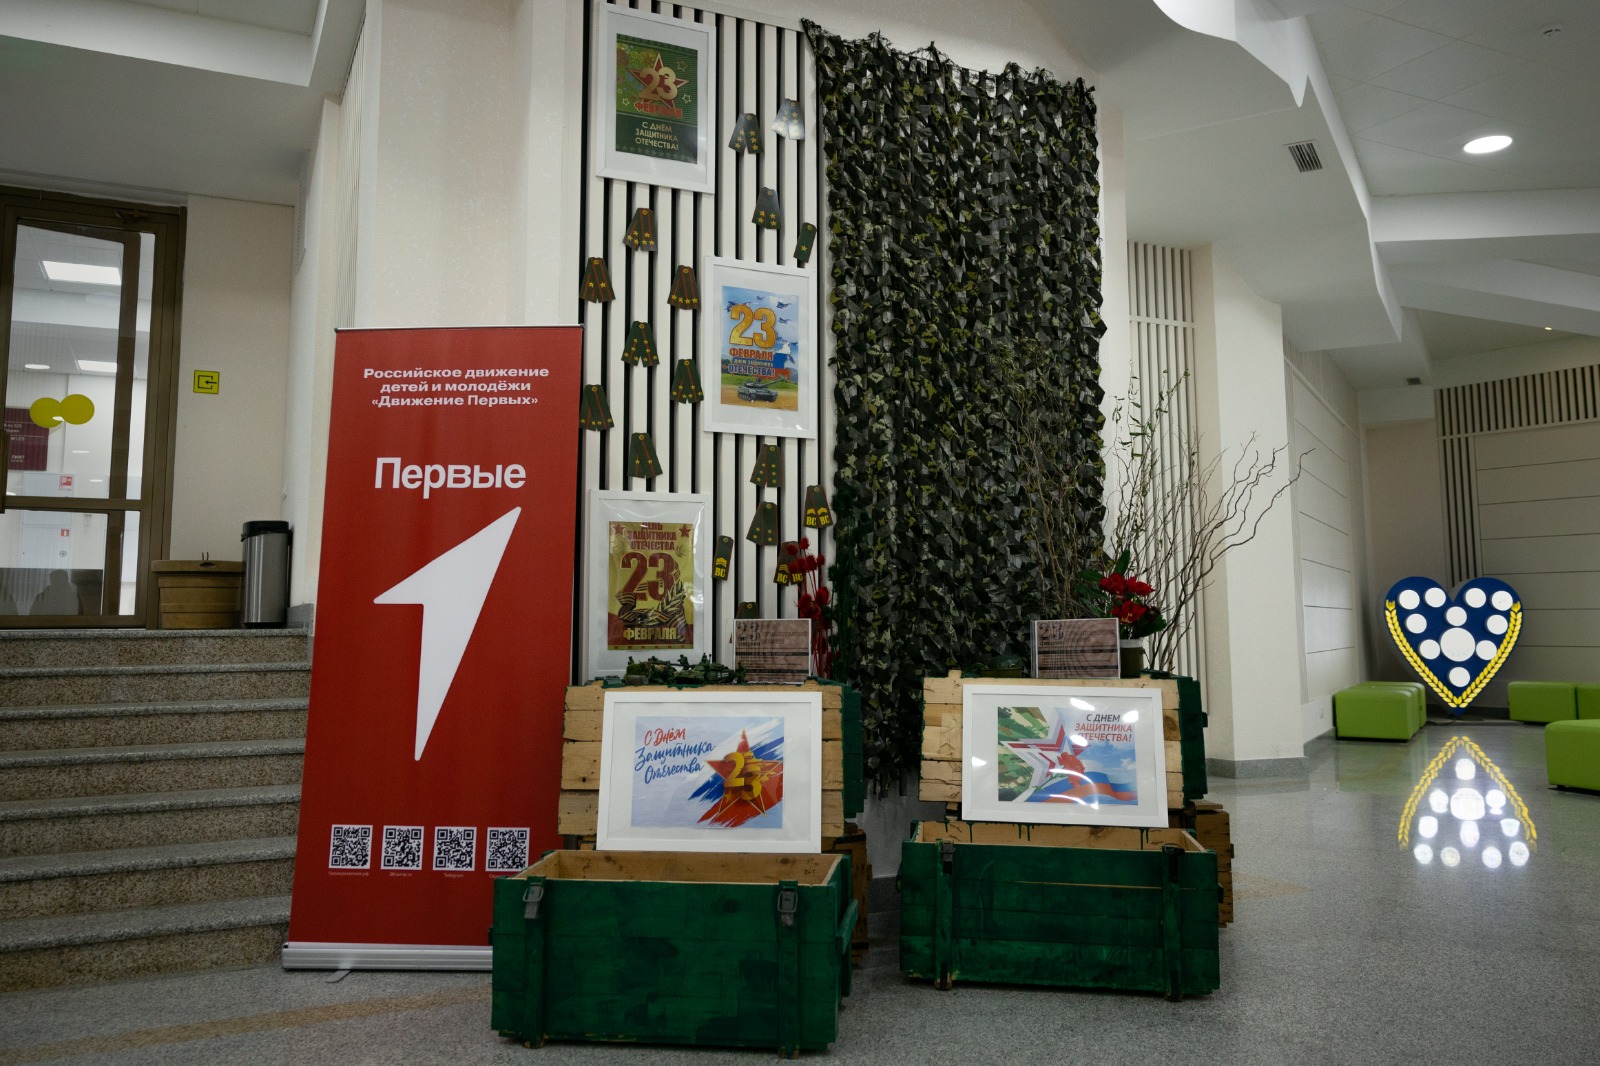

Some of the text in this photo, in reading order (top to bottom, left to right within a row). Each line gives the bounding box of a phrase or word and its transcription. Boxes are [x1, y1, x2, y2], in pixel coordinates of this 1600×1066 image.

[639, 67, 678, 100] 23
[642, 121, 649, 129] С
[635, 128, 678, 142] ЗАЩИТНИКА
[635, 137, 679, 150] ОТЕЧЕСТВА!
[729, 304, 776, 349] 23
[729, 347, 774, 360] ФЕВРАЛЯ
[363, 367, 550, 379] Российское движение
[728, 364, 776, 377] ОТЕЧЕСТВА!
[380, 380, 532, 394] детей и молодёжи
[372, 394, 538, 408] «Движение Первых»
[374, 456, 527, 500] Первые
[628, 530, 676, 541] ЗАЩИТНИКА
[630, 541, 676, 551] ОТЕЧЕСТВА
[620, 551, 677, 602] 23
[622, 627, 677, 640] ФЕВРАЛЯ
[1086, 714, 1121, 723] С ДНЕМ
[1075, 723, 1133, 732] ЗАЩИТНИКА
[644, 730, 653, 746] С
[634, 741, 717, 772] Защитника
[644, 757, 705, 784] Отечества
